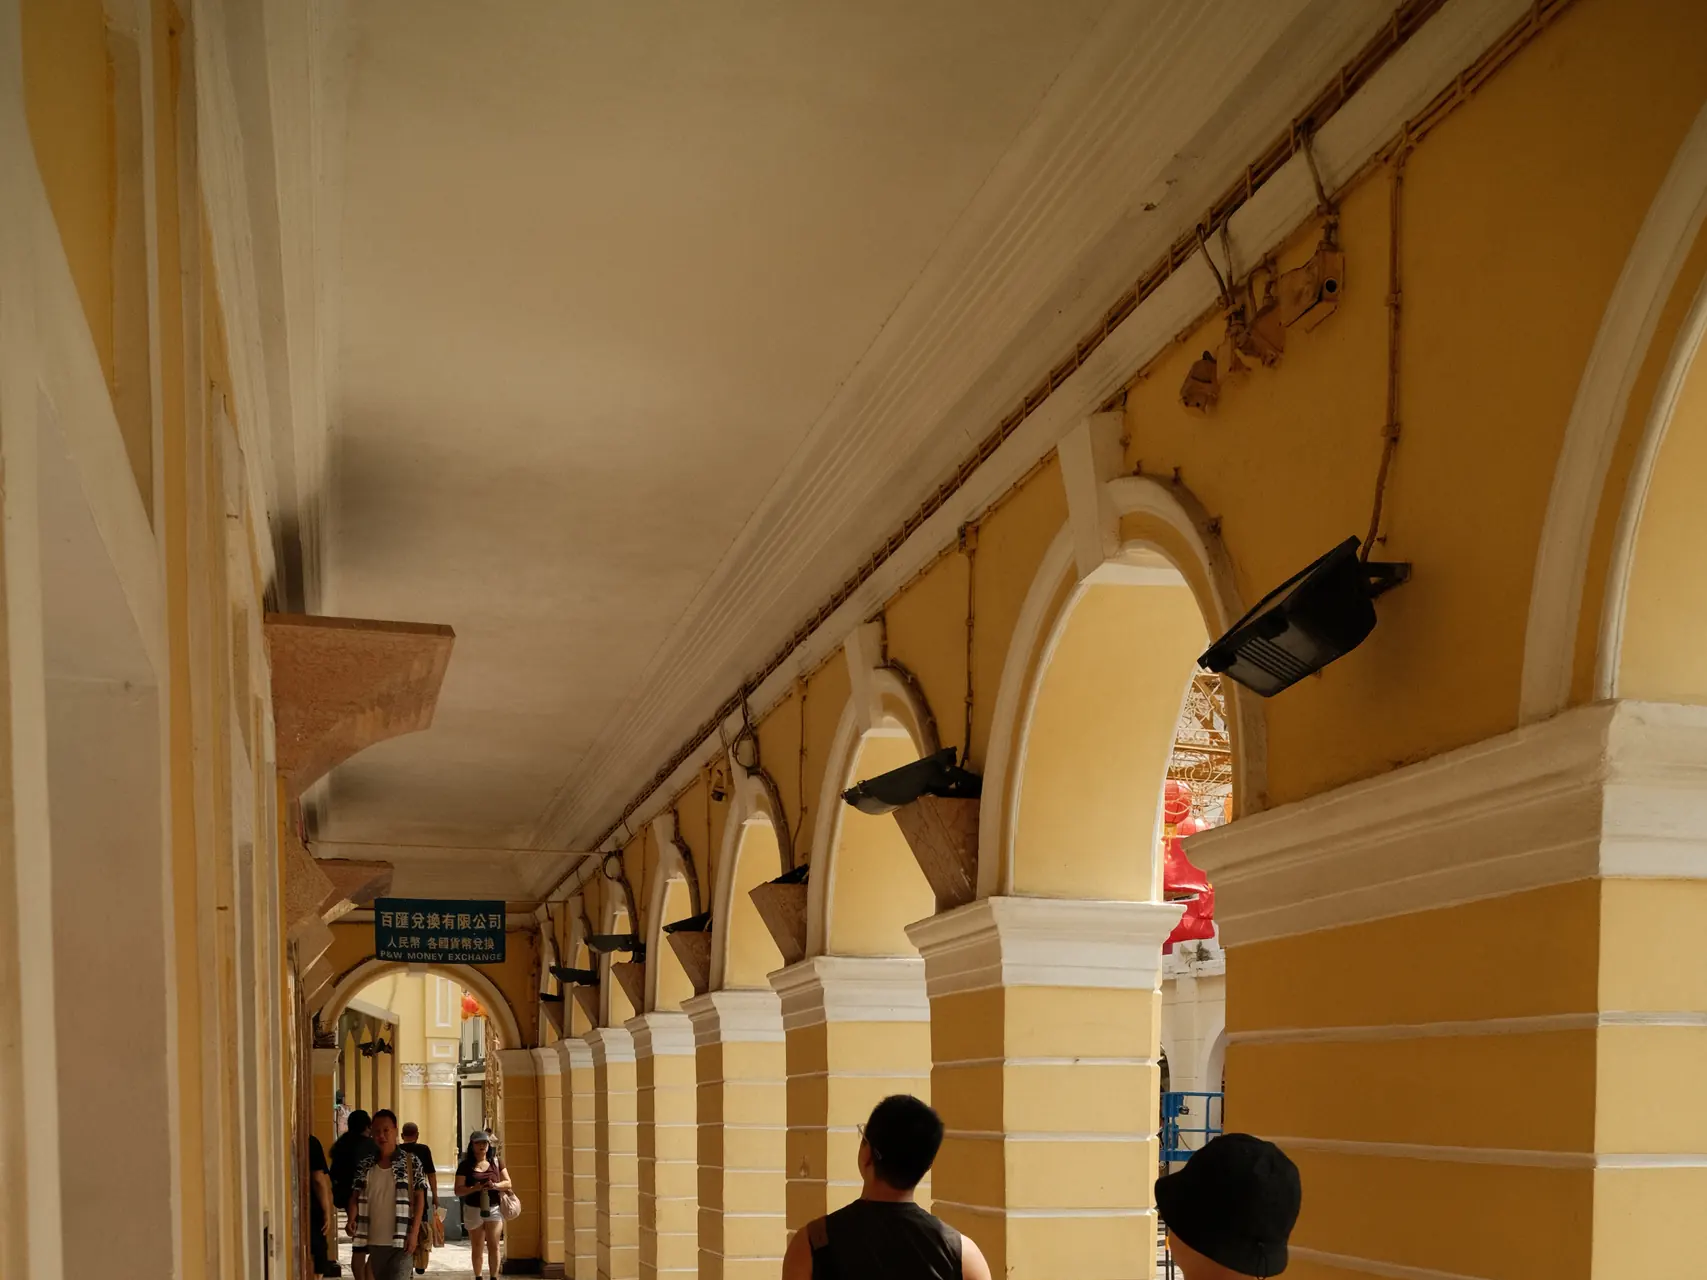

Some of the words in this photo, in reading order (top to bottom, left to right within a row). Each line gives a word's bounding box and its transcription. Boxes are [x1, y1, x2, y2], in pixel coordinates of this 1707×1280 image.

[380, 911, 501, 930] 百匯兌換有限公司
[387, 935, 421, 949] 人民幣
[380, 950, 402, 959] P&W
[407, 952, 443, 961] MONEY
[448, 952, 502, 961] EXCHANGE
